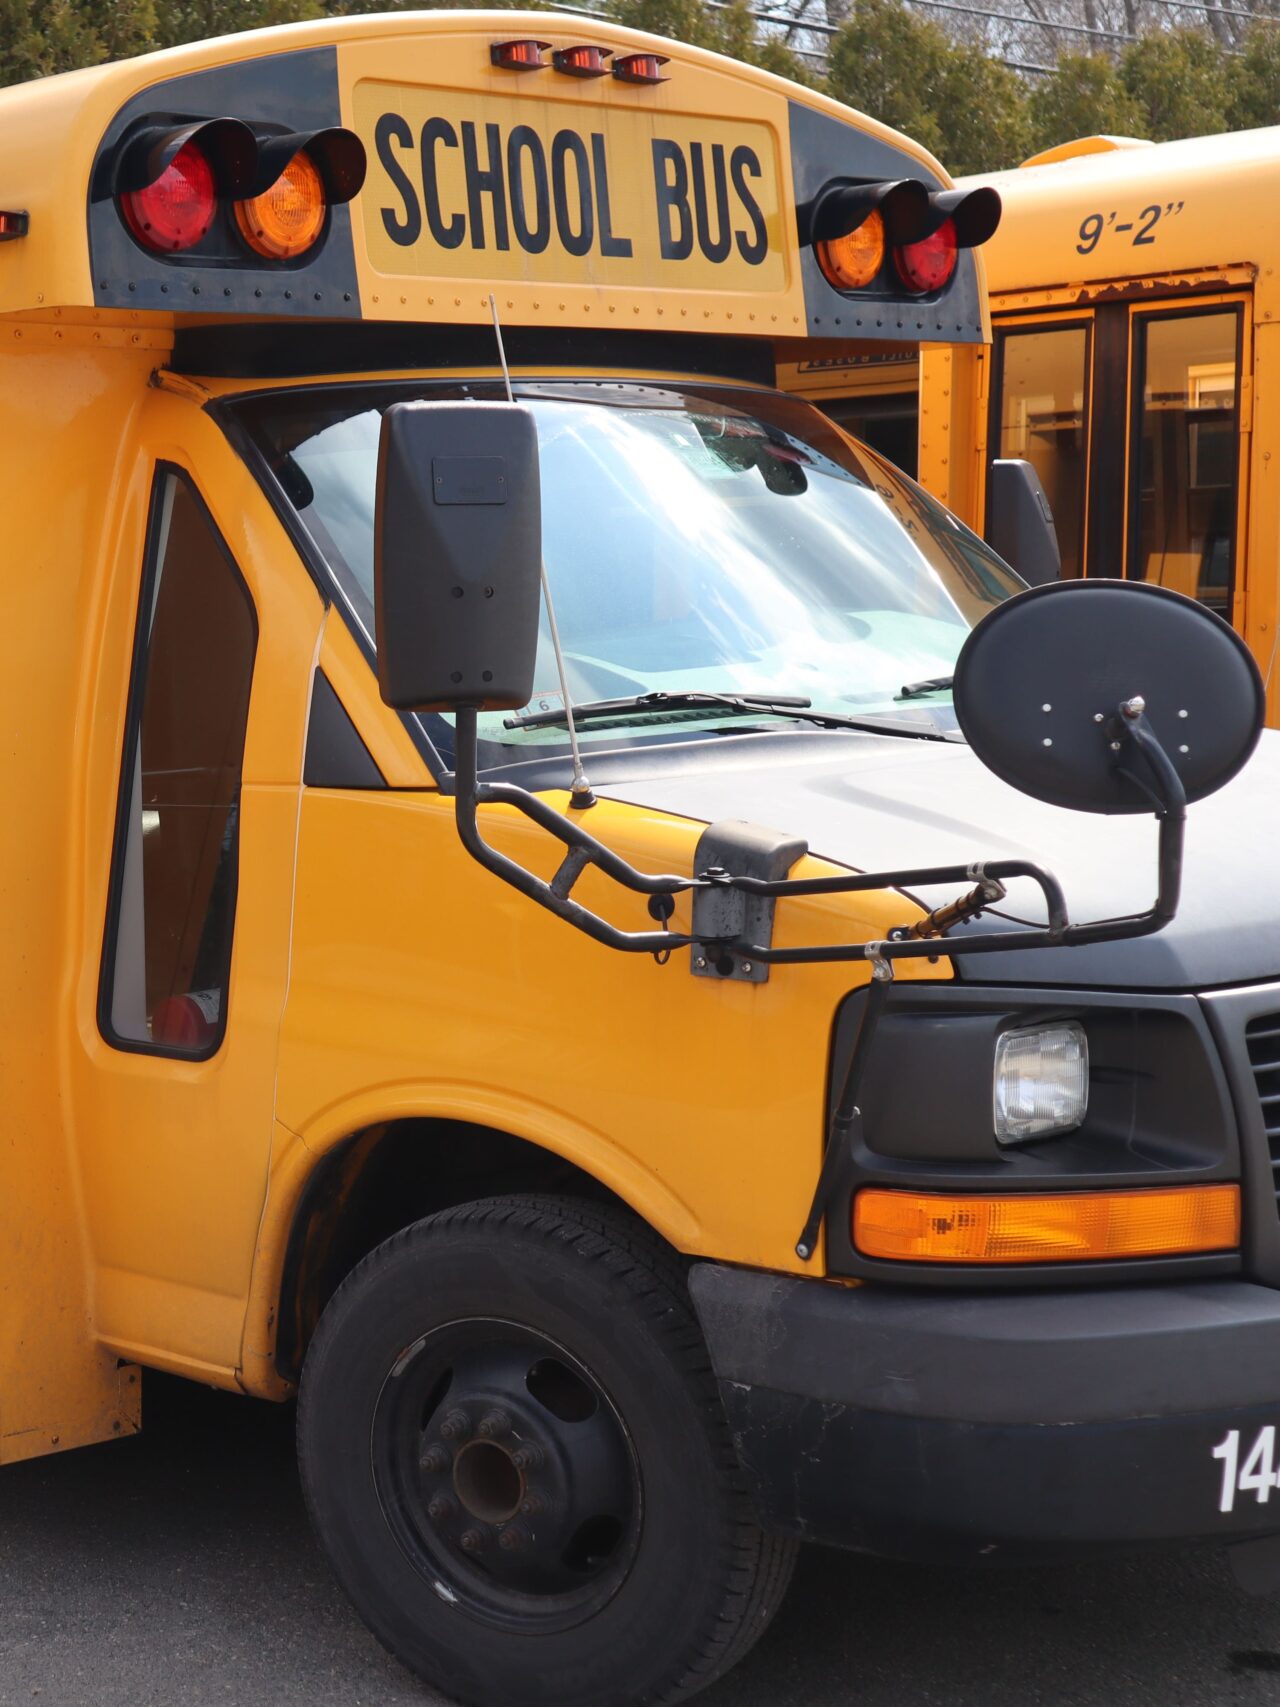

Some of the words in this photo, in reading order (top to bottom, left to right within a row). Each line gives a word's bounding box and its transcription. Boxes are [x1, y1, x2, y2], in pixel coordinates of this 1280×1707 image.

[374, 112, 633, 259] SCHOOL
[651, 138, 768, 266] BUS
[1211, 1425, 1280, 1513] 14
